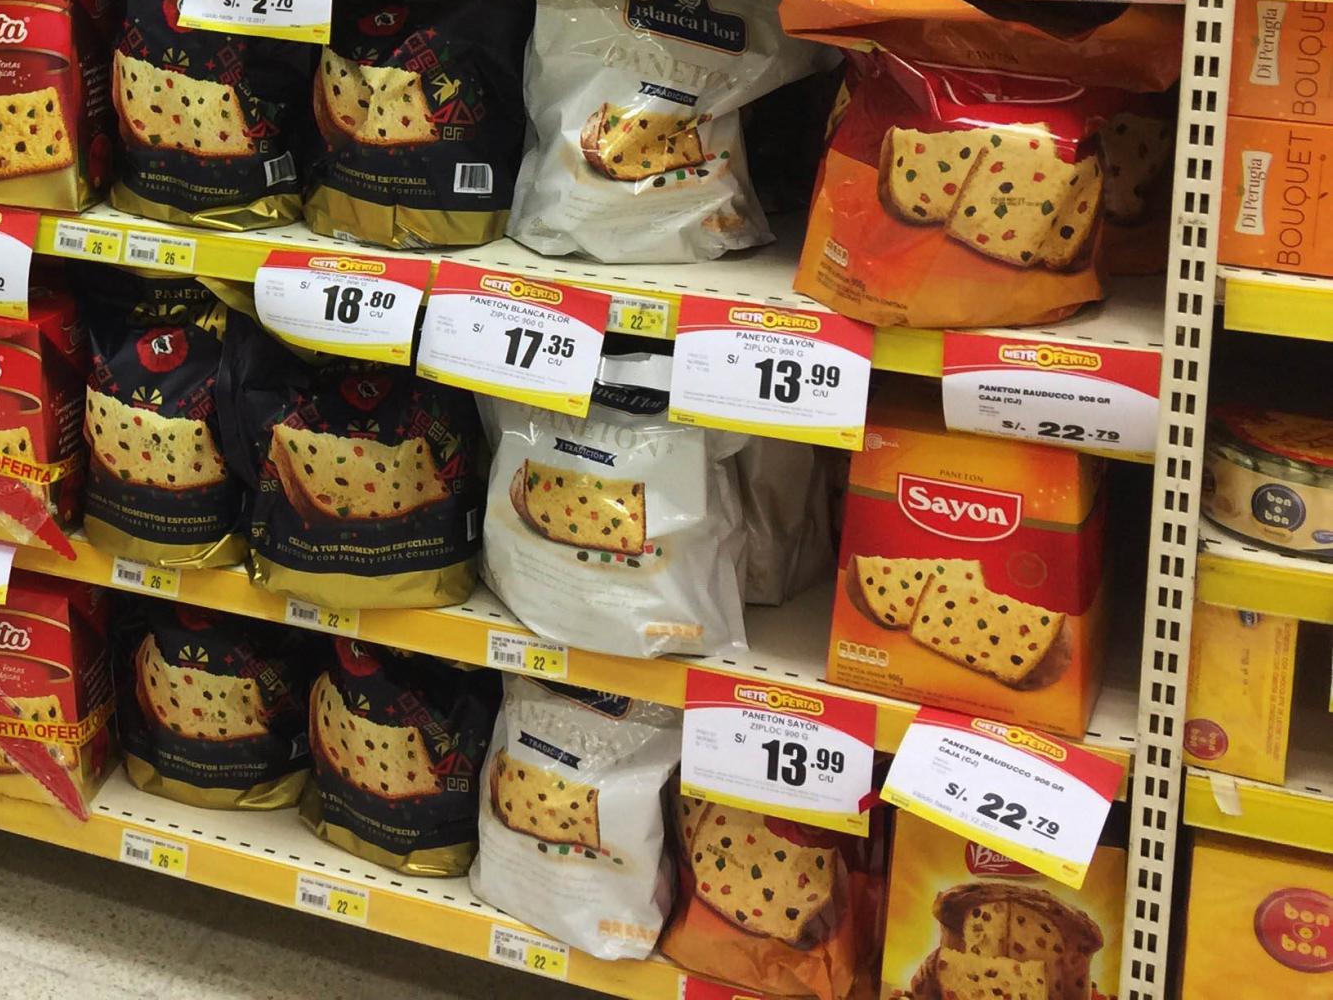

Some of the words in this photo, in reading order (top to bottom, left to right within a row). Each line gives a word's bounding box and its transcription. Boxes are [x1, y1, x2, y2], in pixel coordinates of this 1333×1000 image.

[705, 19, 740, 43] Flor
[1258, 8, 1282, 62] Perugia
[1244, 158, 1267, 209] Perugia
[1277, 131, 1313, 266] BOUQUET
[299, 280, 311, 291] S/
[322, 284, 396, 324] 18.80
[484, 279, 561, 302] METROFERTAS
[512, 305, 546, 320] BLANCA
[548, 313, 570, 325] FLOR
[731, 311, 818, 331] METROFERTAS
[472, 323, 485, 335] S/
[504, 327, 575, 369] 17.35
[547, 356, 562, 367] C/U
[743, 343, 774, 353] ZIPLOC
[1002, 348, 1098, 368] METROFERTAS
[727, 353, 739, 365] S/
[754, 358, 840, 404] 13.99
[812, 388, 828, 399] C/U
[978, 384, 1020, 397] PANETON
[1023, 388, 1075, 401] BAUDUCCO
[978, 394, 1001, 403] CAJA
[1038, 421, 1120, 442] 22.79
[908, 485, 1008, 528] Sayon
[734, 732, 747, 745] S/
[762, 739, 845, 788] 13.99
[938, 745, 959, 759] CAJA
[942, 736, 984, 759] PANETON
[983, 751, 1033, 778] BAUDUCCO
[977, 791, 1061, 839] 22.79
[1281, 900, 1331, 927] bon
[1280, 931, 1327, 961] bon
